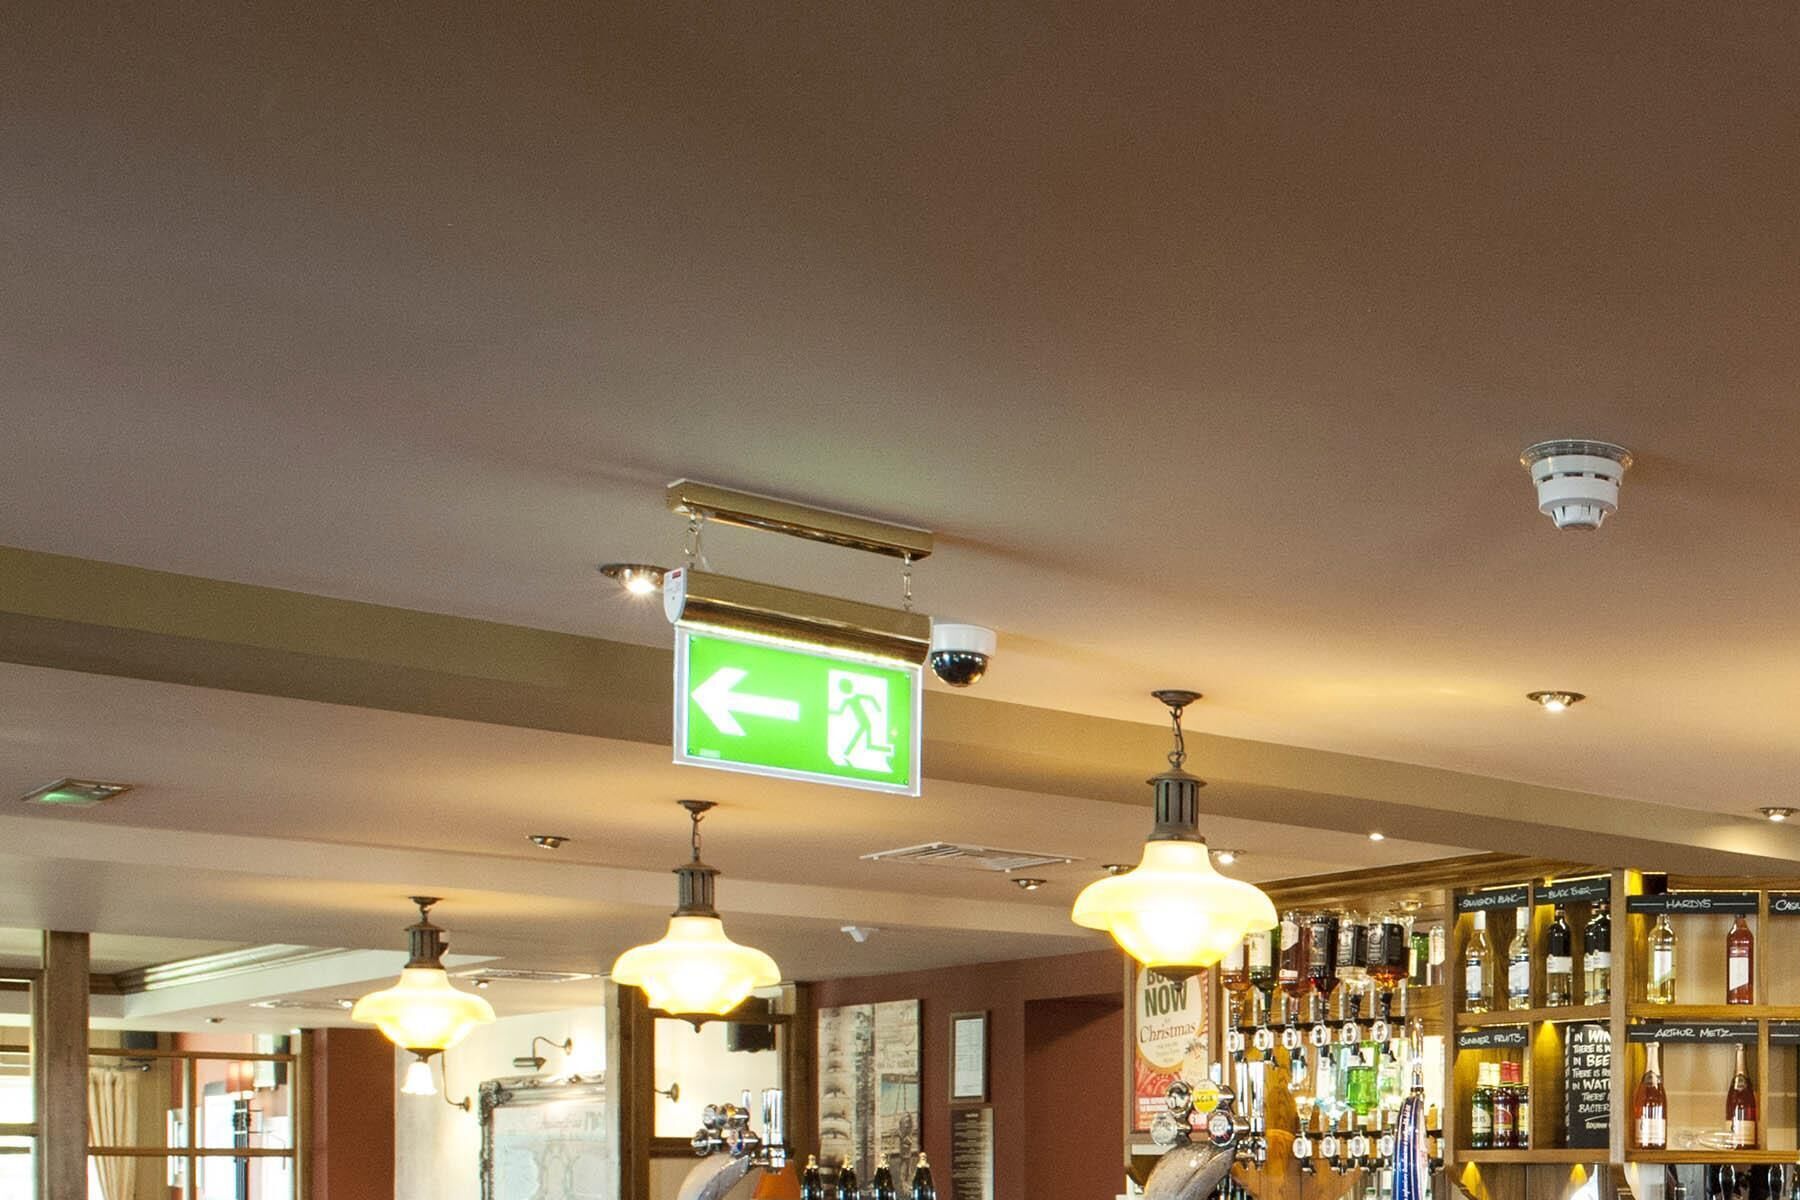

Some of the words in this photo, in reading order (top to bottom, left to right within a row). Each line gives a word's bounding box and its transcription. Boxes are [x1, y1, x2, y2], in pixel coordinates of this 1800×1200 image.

[1666, 899, 1712, 909] HARDYS
[1144, 982, 1188, 1018] NOW
[1140, 1022, 1196, 1044] Christmas
[1494, 1033, 1521, 1044] FRUITS
[1574, 1031, 1583, 1043] IN
[1588, 1029, 1611, 1044] WIN
[1654, 1028, 1697, 1038] ARTHUR
[1699, 1028, 1734, 1038] METZ
[1586, 1054, 1611, 1067] BEE
[1583, 1078, 1611, 1091] WAT
[1578, 1104, 1611, 1114] BACTER
